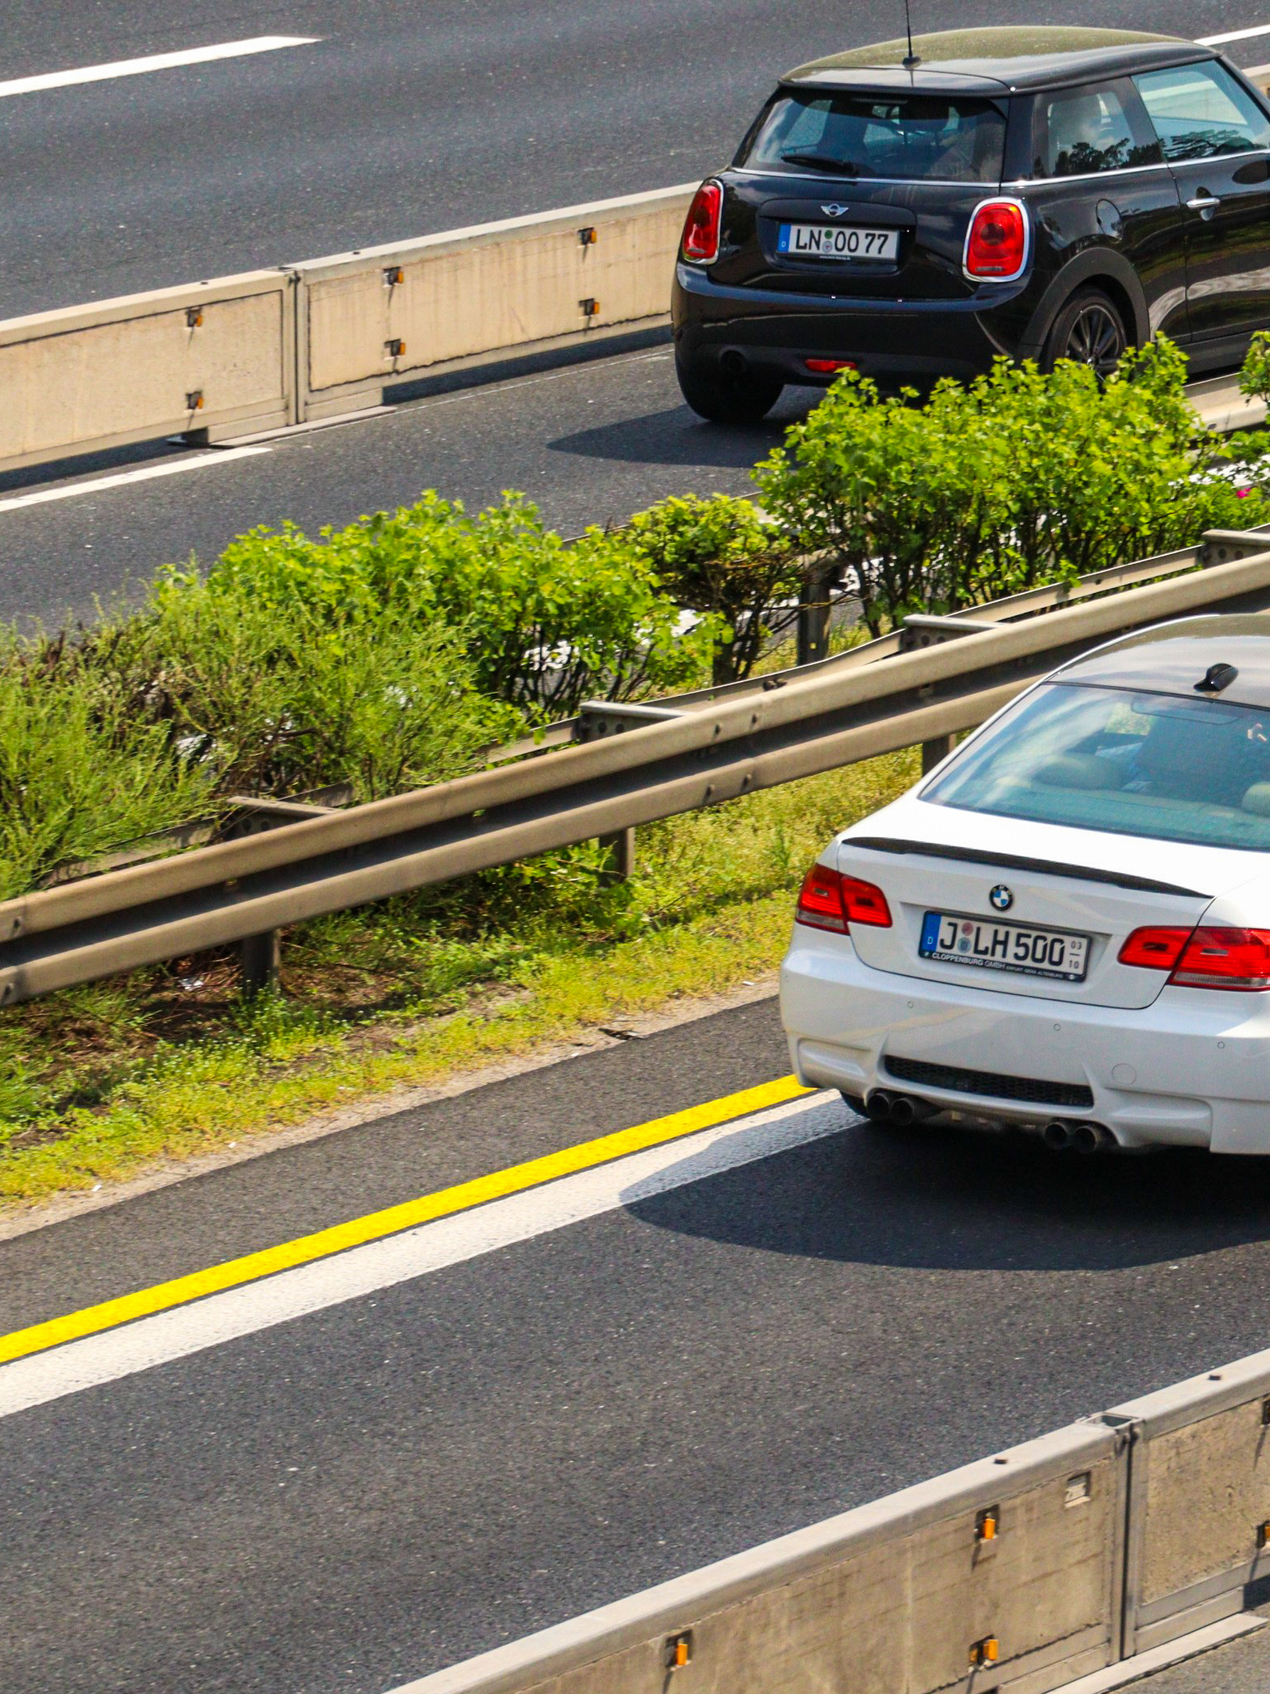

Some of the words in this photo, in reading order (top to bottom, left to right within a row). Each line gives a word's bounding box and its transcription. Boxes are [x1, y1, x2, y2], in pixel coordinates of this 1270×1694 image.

[795, 229, 822, 250] LN
[864, 233, 889, 255] 77
[926, 936, 933, 945] D
[939, 922, 958, 950] J
[973, 926, 1010, 959] LH
[1013, 932, 1065, 967] 500
[1070, 940, 1082, 950] 03
[931, 952, 984, 967] CLOPPENBURG
[1068, 960, 1080, 969] 10
